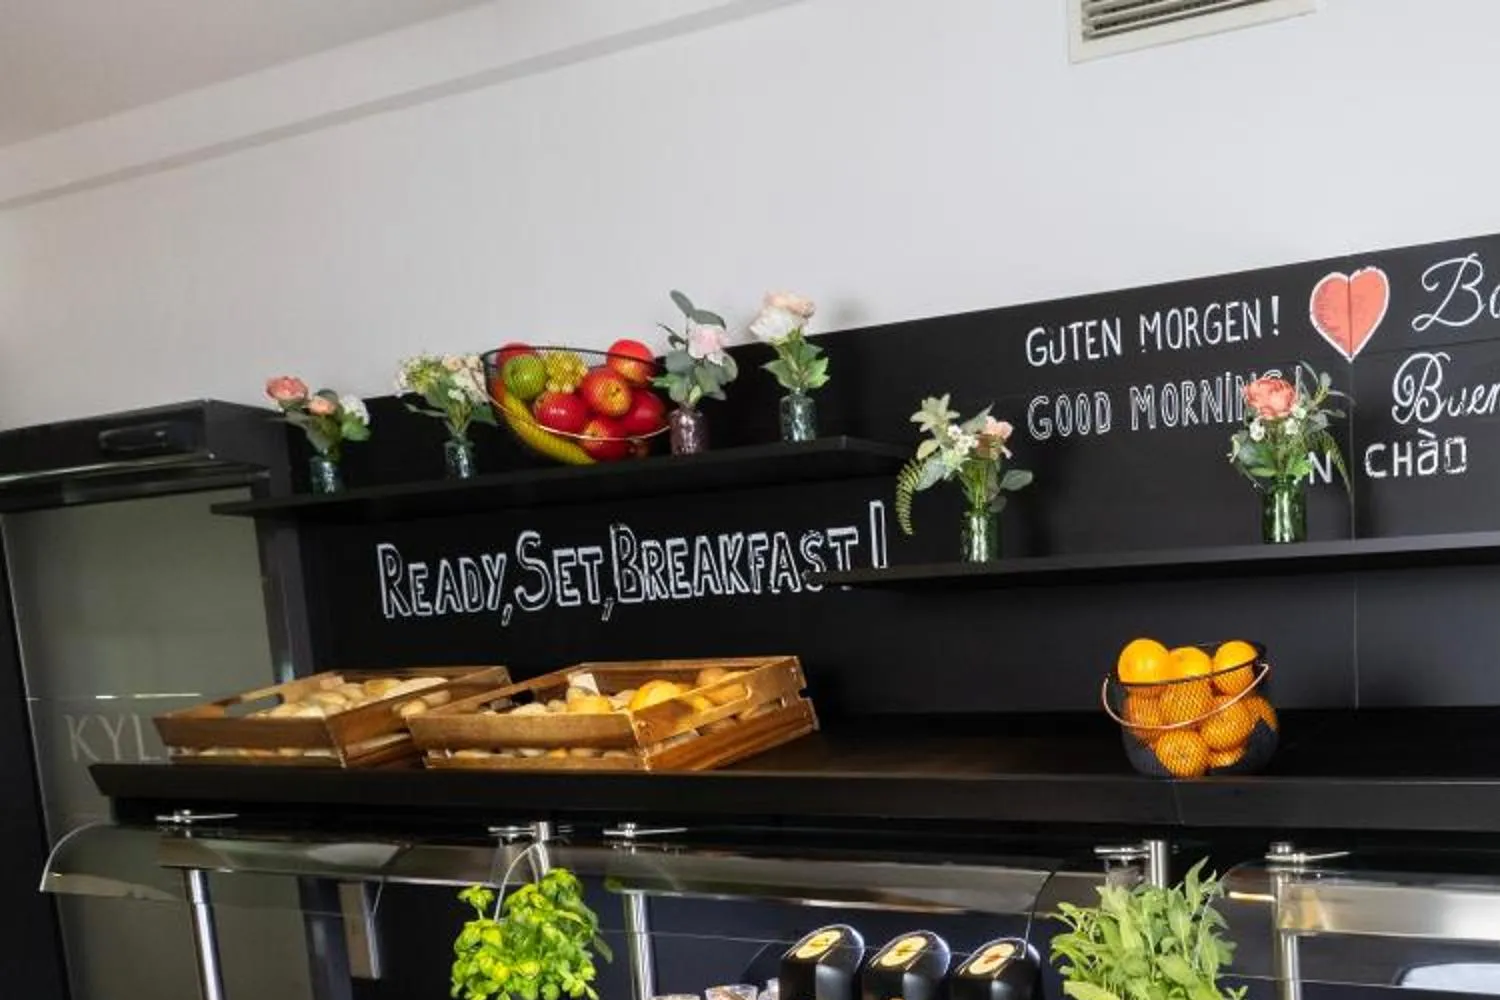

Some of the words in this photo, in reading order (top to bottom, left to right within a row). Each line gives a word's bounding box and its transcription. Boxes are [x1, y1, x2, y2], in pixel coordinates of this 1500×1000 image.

[1025, 316, 1122, 367] GUTEN
[1139, 295, 1280, 352] MORGEN!
[1027, 391, 1112, 441] GOOD
[64, 713, 171, 764] KYL
